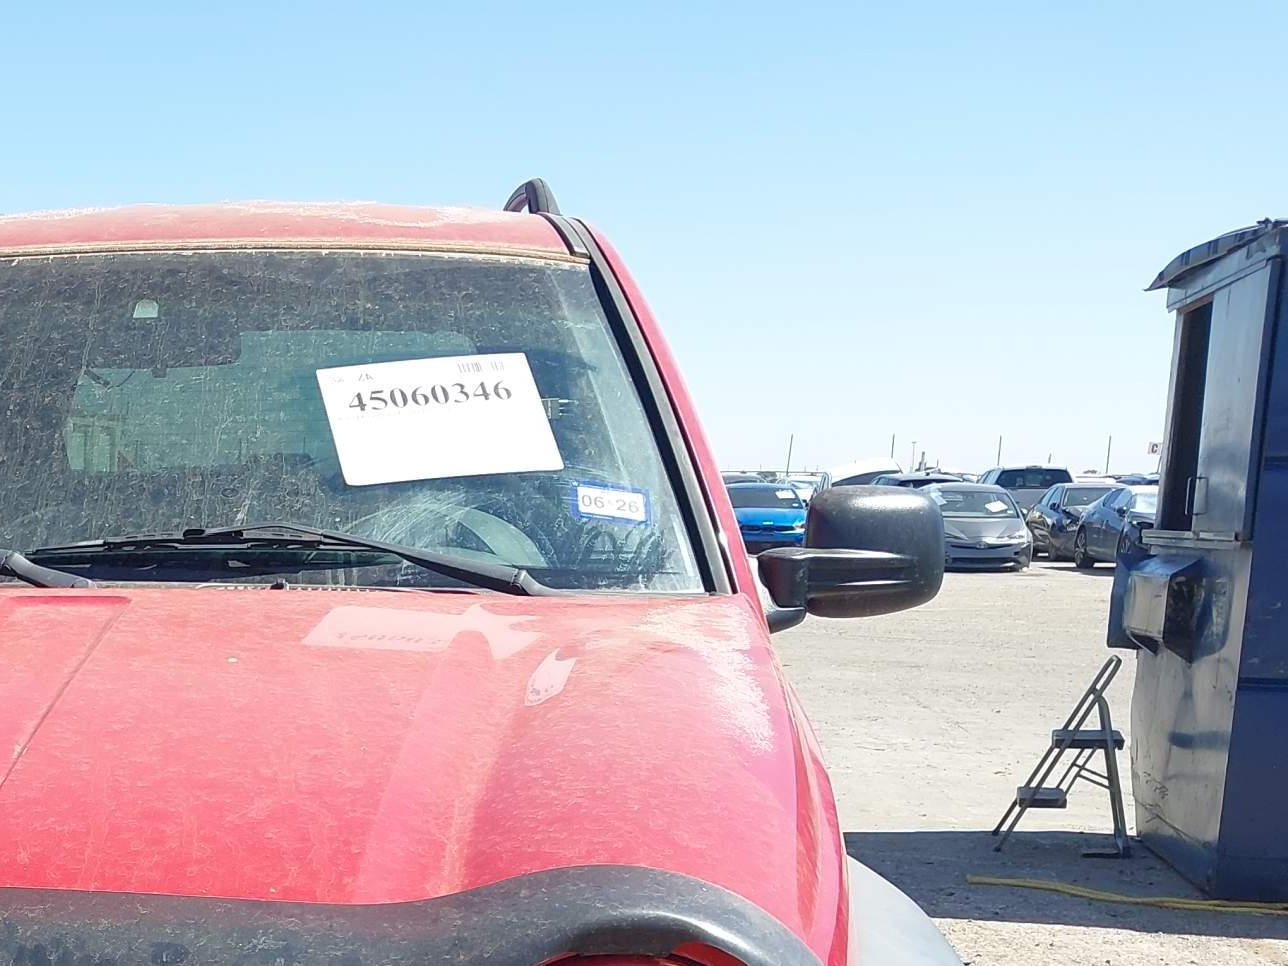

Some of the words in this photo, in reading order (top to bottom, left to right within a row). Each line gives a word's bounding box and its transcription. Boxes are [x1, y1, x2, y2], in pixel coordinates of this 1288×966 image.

[348, 380, 513, 412] 45060346
[581, 494, 605, 509] 06
[615, 498, 640, 514] 26
